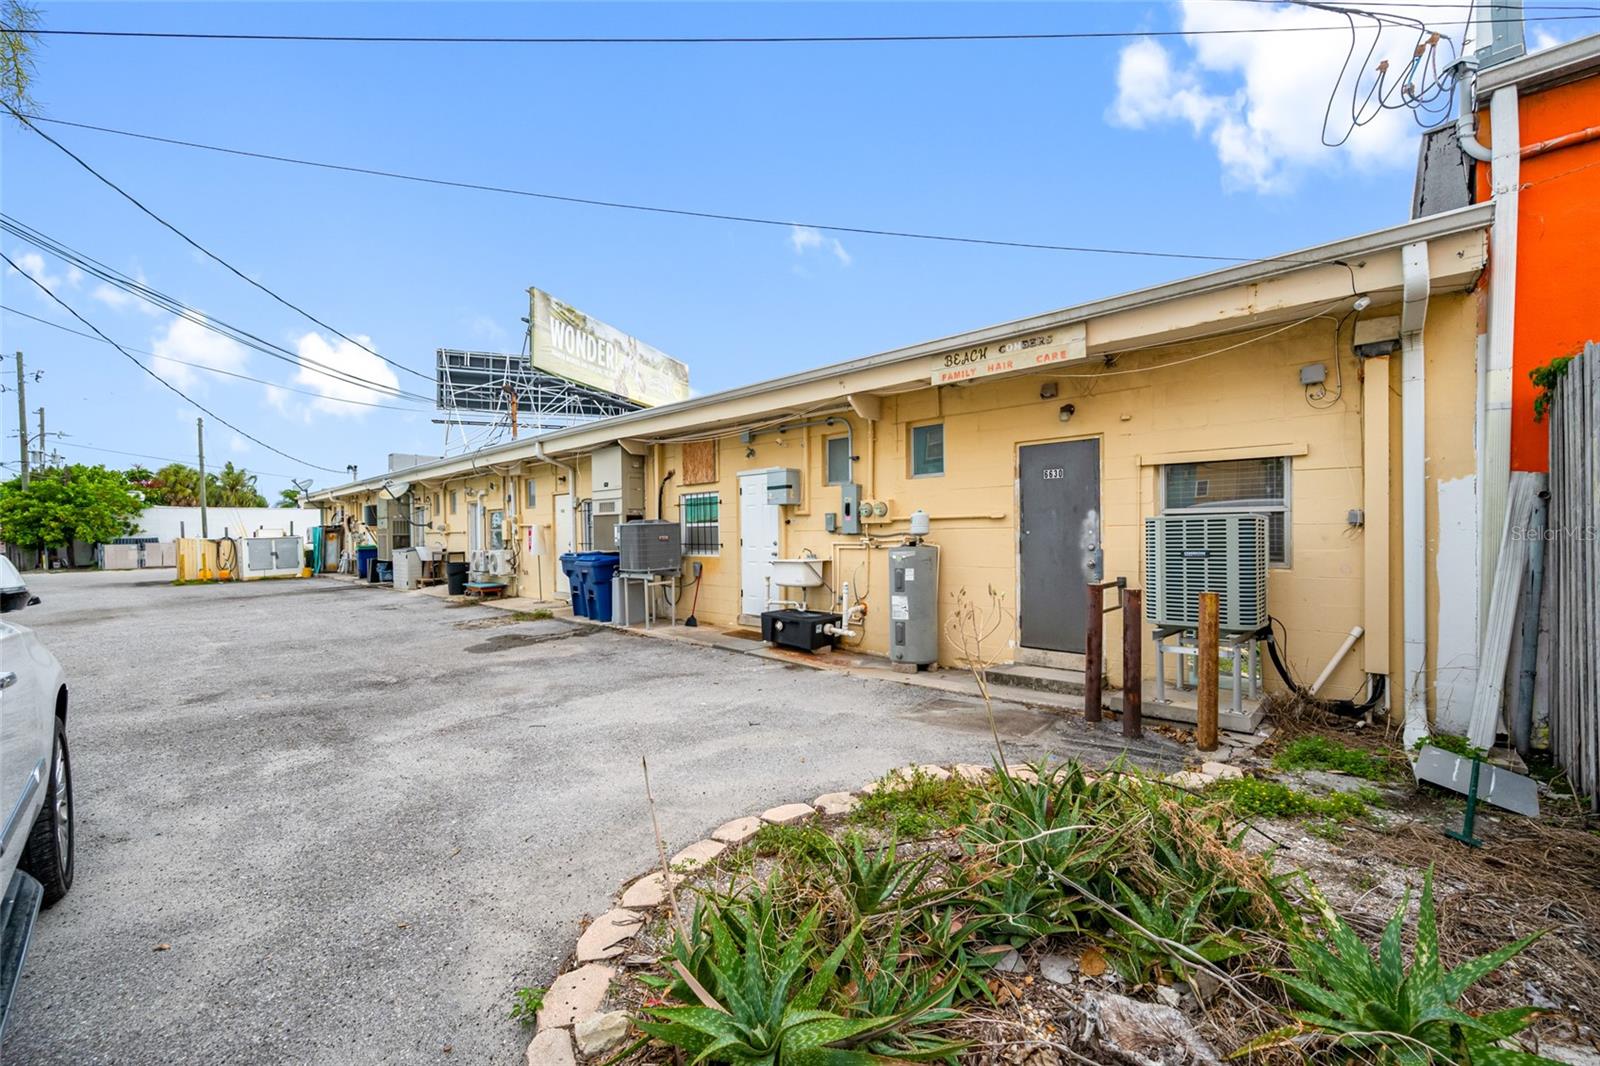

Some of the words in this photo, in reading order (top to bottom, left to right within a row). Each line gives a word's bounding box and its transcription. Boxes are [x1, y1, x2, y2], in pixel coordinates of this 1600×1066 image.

[941, 367, 977, 382] FAMILY
[987, 360, 1014, 372] HAIR
[1036, 350, 1068, 364] CARE
[944, 347, 988, 368] BEACH
